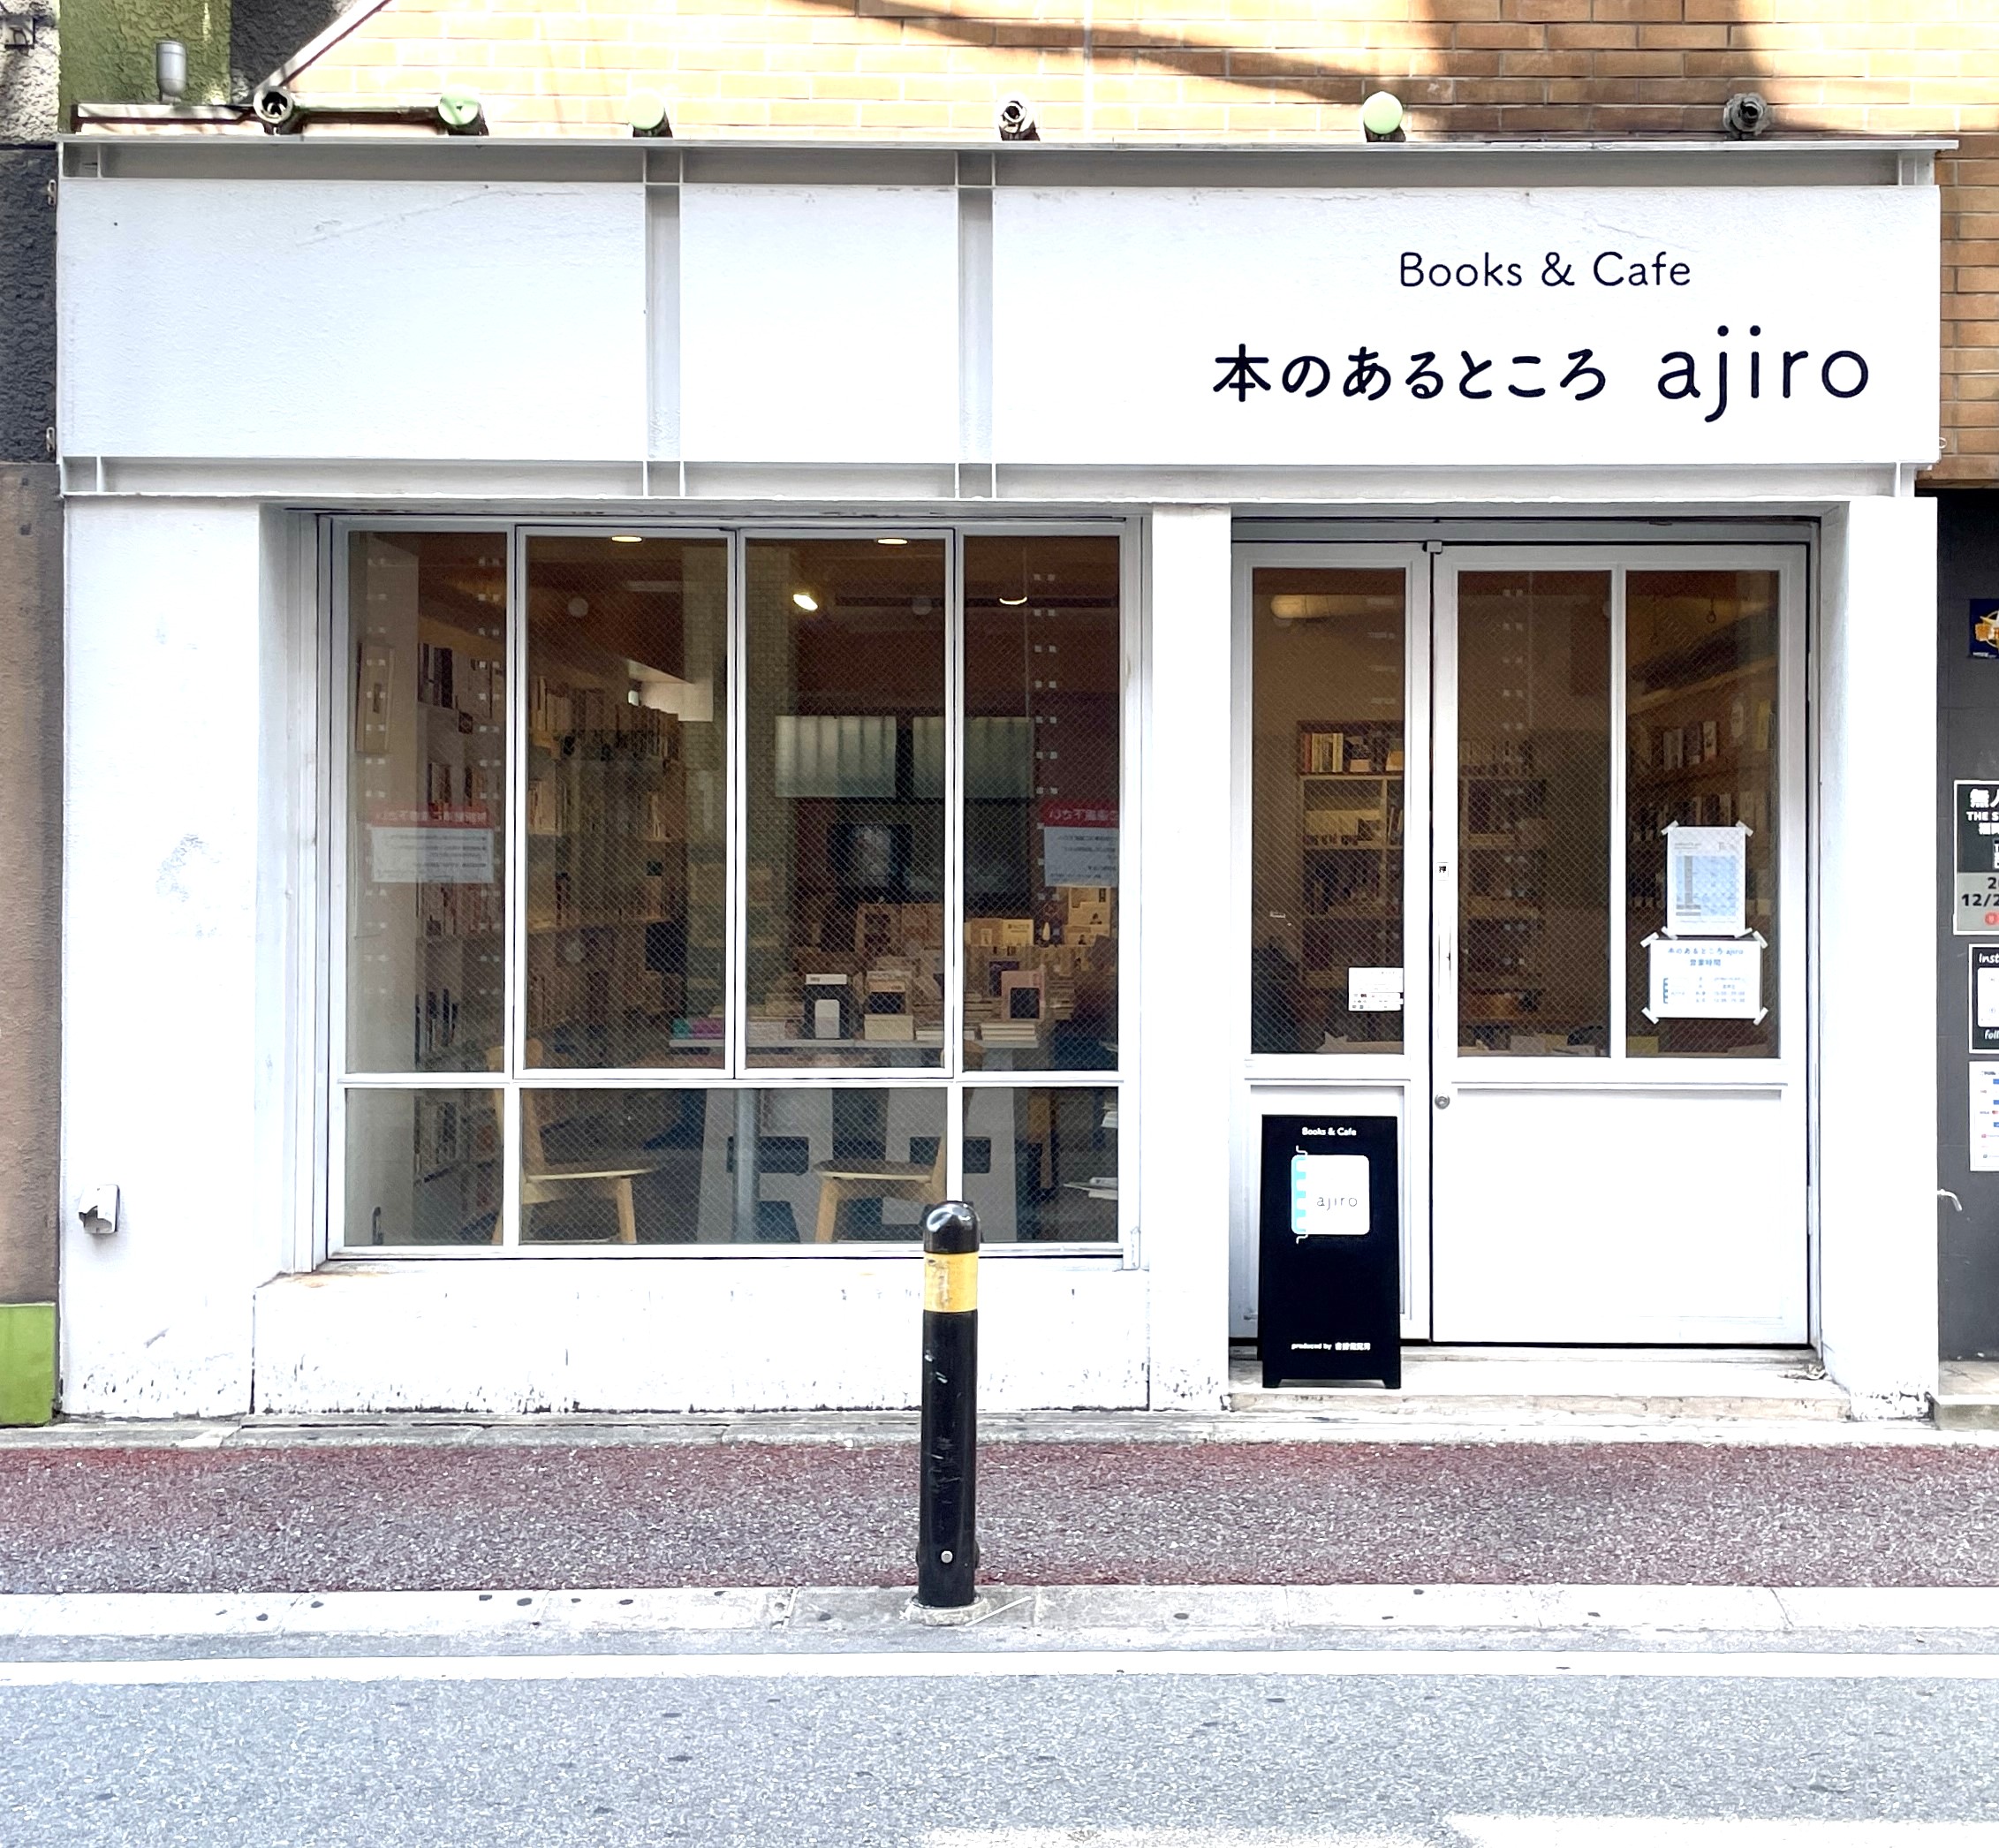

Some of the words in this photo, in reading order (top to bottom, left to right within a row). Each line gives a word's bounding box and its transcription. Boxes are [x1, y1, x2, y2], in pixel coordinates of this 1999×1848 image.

[1400, 252, 1523, 287] Books
[1541, 251, 1575, 287] &
[1593, 251, 1691, 287] Cafe
[1212, 343, 1606, 403] 本のあるところ
[1657, 324, 1869, 423] ajiro
[1966, 811, 1988, 822] THE
[1301, 1126, 1327, 1136] Books
[1327, 1126, 1336, 1136] &
[1336, 1126, 1357, 1136] Cafe
[1316, 1195, 1358, 1211] ajiro
